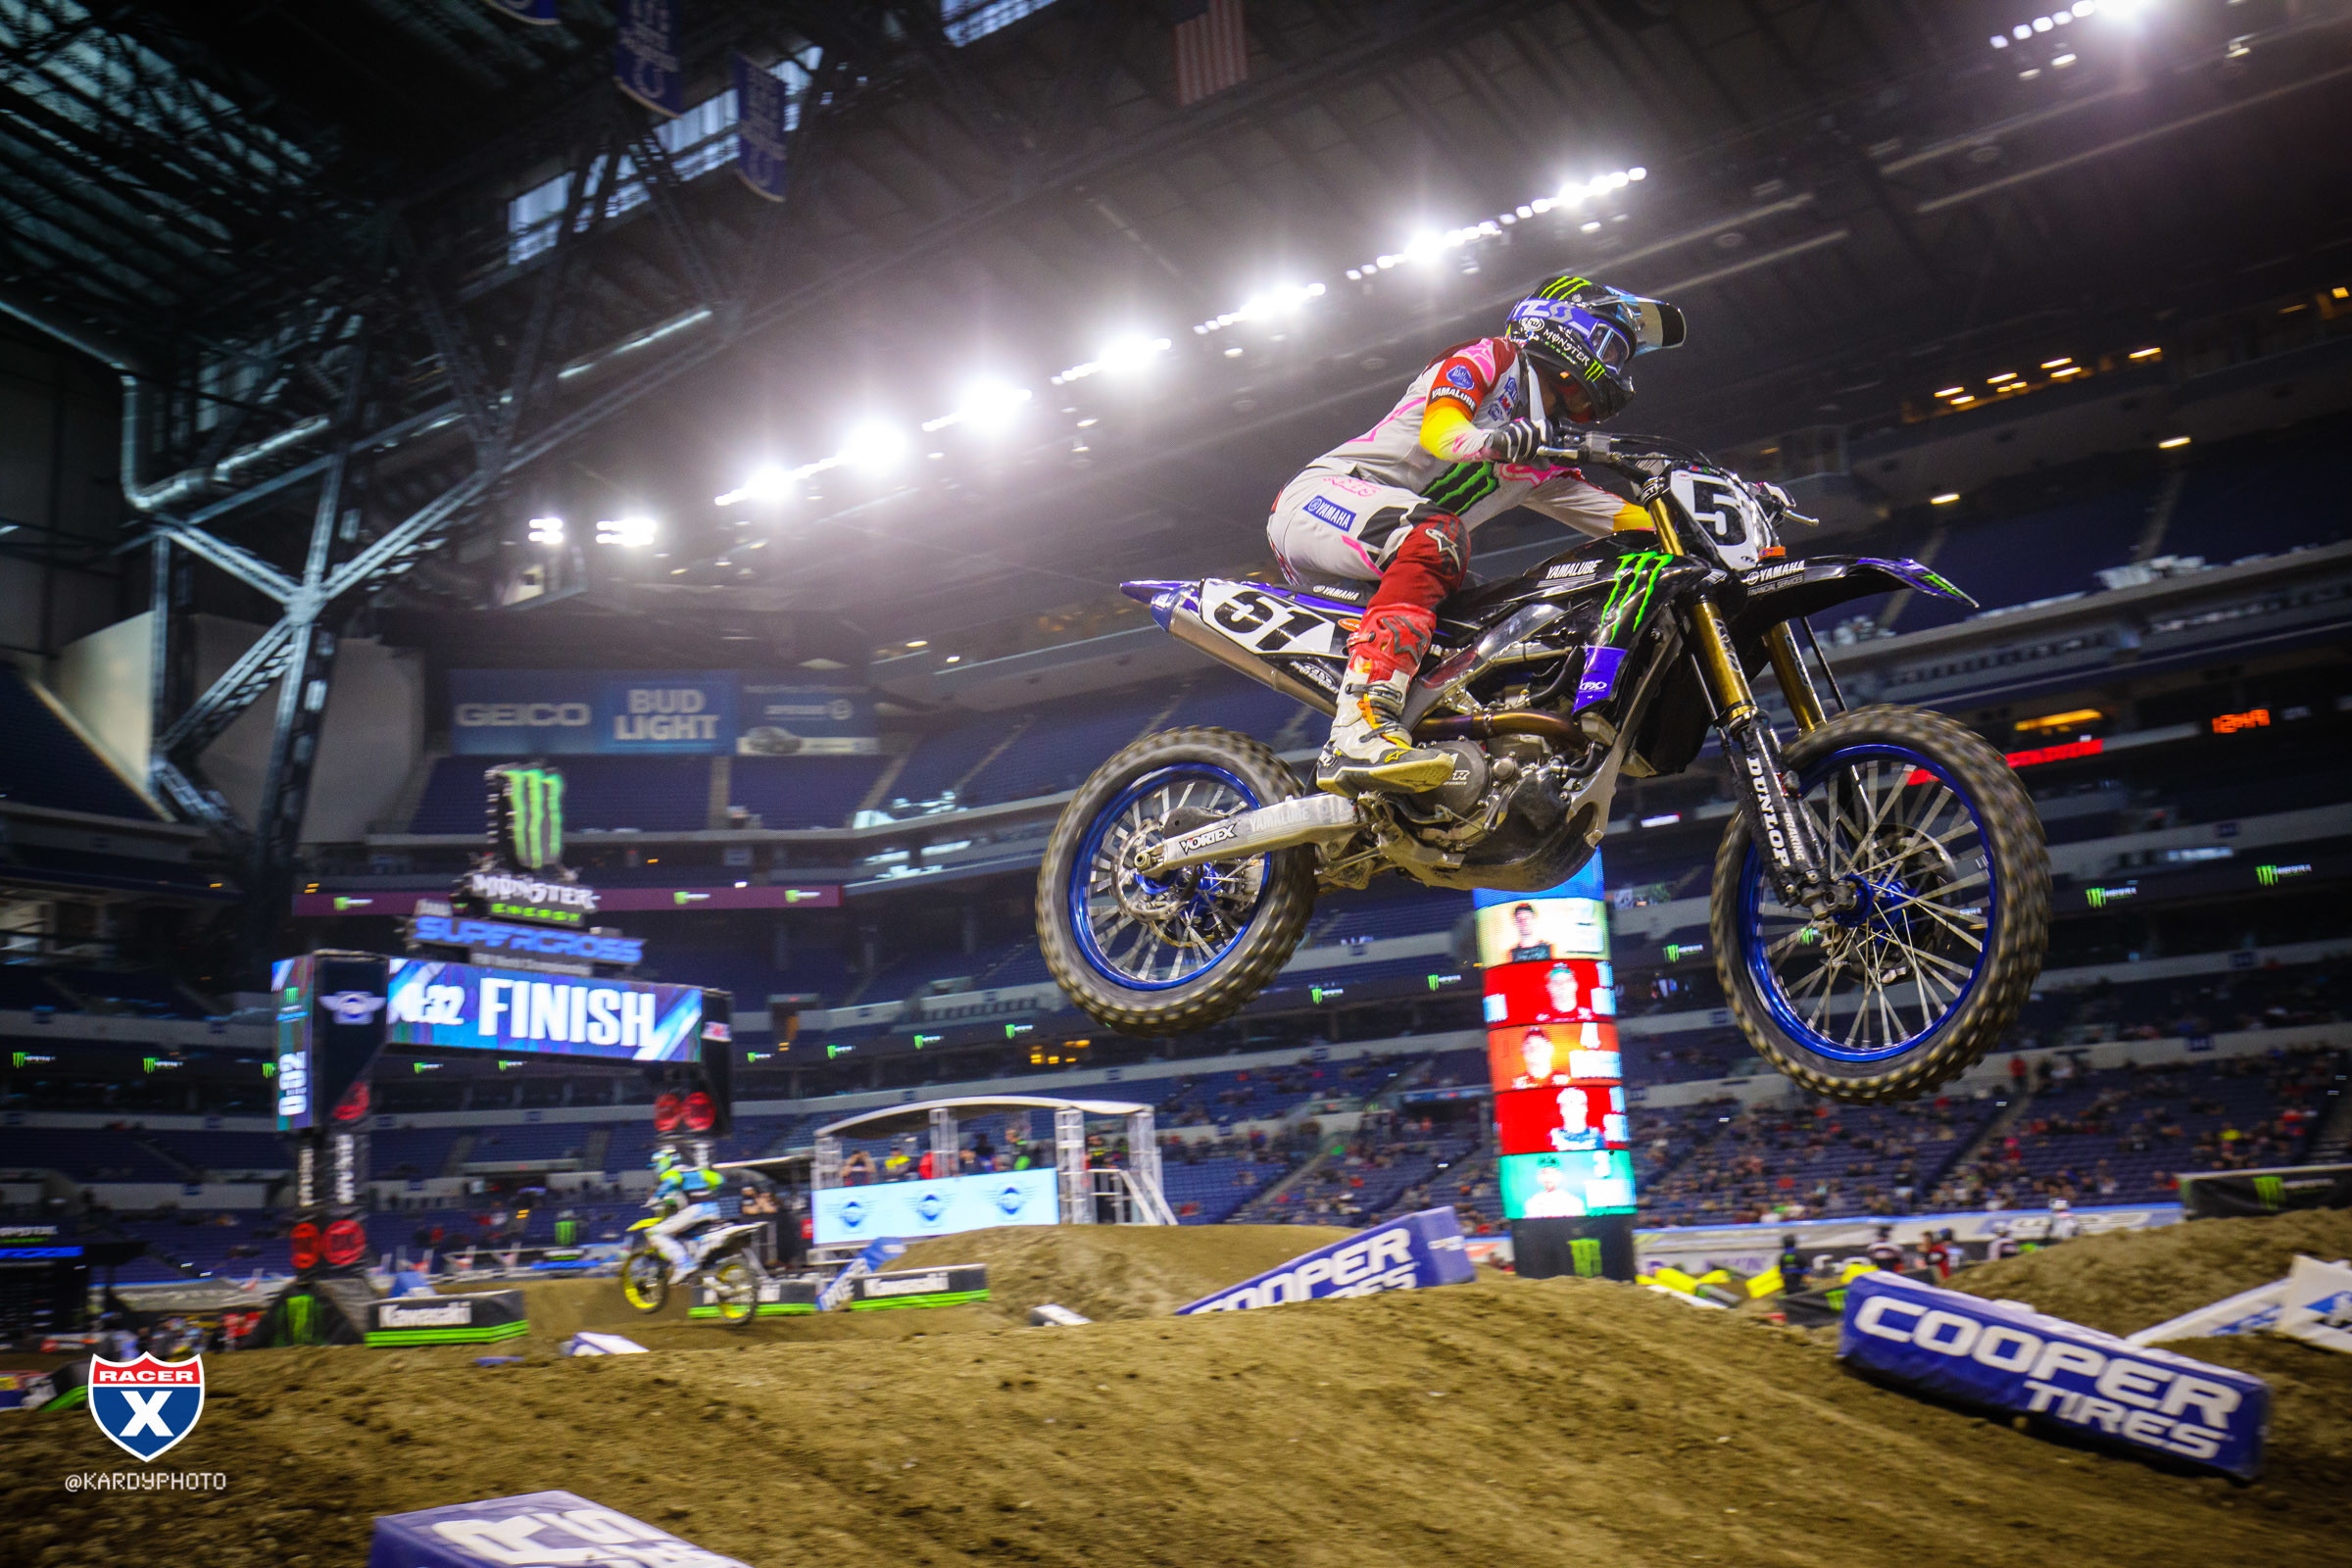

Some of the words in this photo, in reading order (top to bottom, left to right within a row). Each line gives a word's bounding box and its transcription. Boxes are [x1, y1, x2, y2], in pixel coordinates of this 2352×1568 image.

[1315, 502, 1351, 529] YAMAHA
[1545, 560, 1603, 579] YAMALUBE
[1760, 560, 1805, 582] YAMAHA
[1323, 586, 1360, 602] YAMAHA
[454, 703, 591, 726] GEICO
[627, 689, 707, 713] BUD
[613, 714, 720, 740] LIGHT
[1250, 807, 1310, 833] YAMALUBE
[1746, 757, 1791, 867] DUNLOP
[1179, 823, 1238, 855] VORTEX
[1784, 812, 1806, 860] BRAKING
[472, 873, 601, 910] MONSTER
[415, 915, 646, 962] SUPERCROSS
[478, 977, 656, 1047] FINISH
[378, 1300, 472, 1327] Kawasaki
[1854, 1295, 2242, 1429] COOPER
[2023, 1380, 2230, 1459] TIRES
